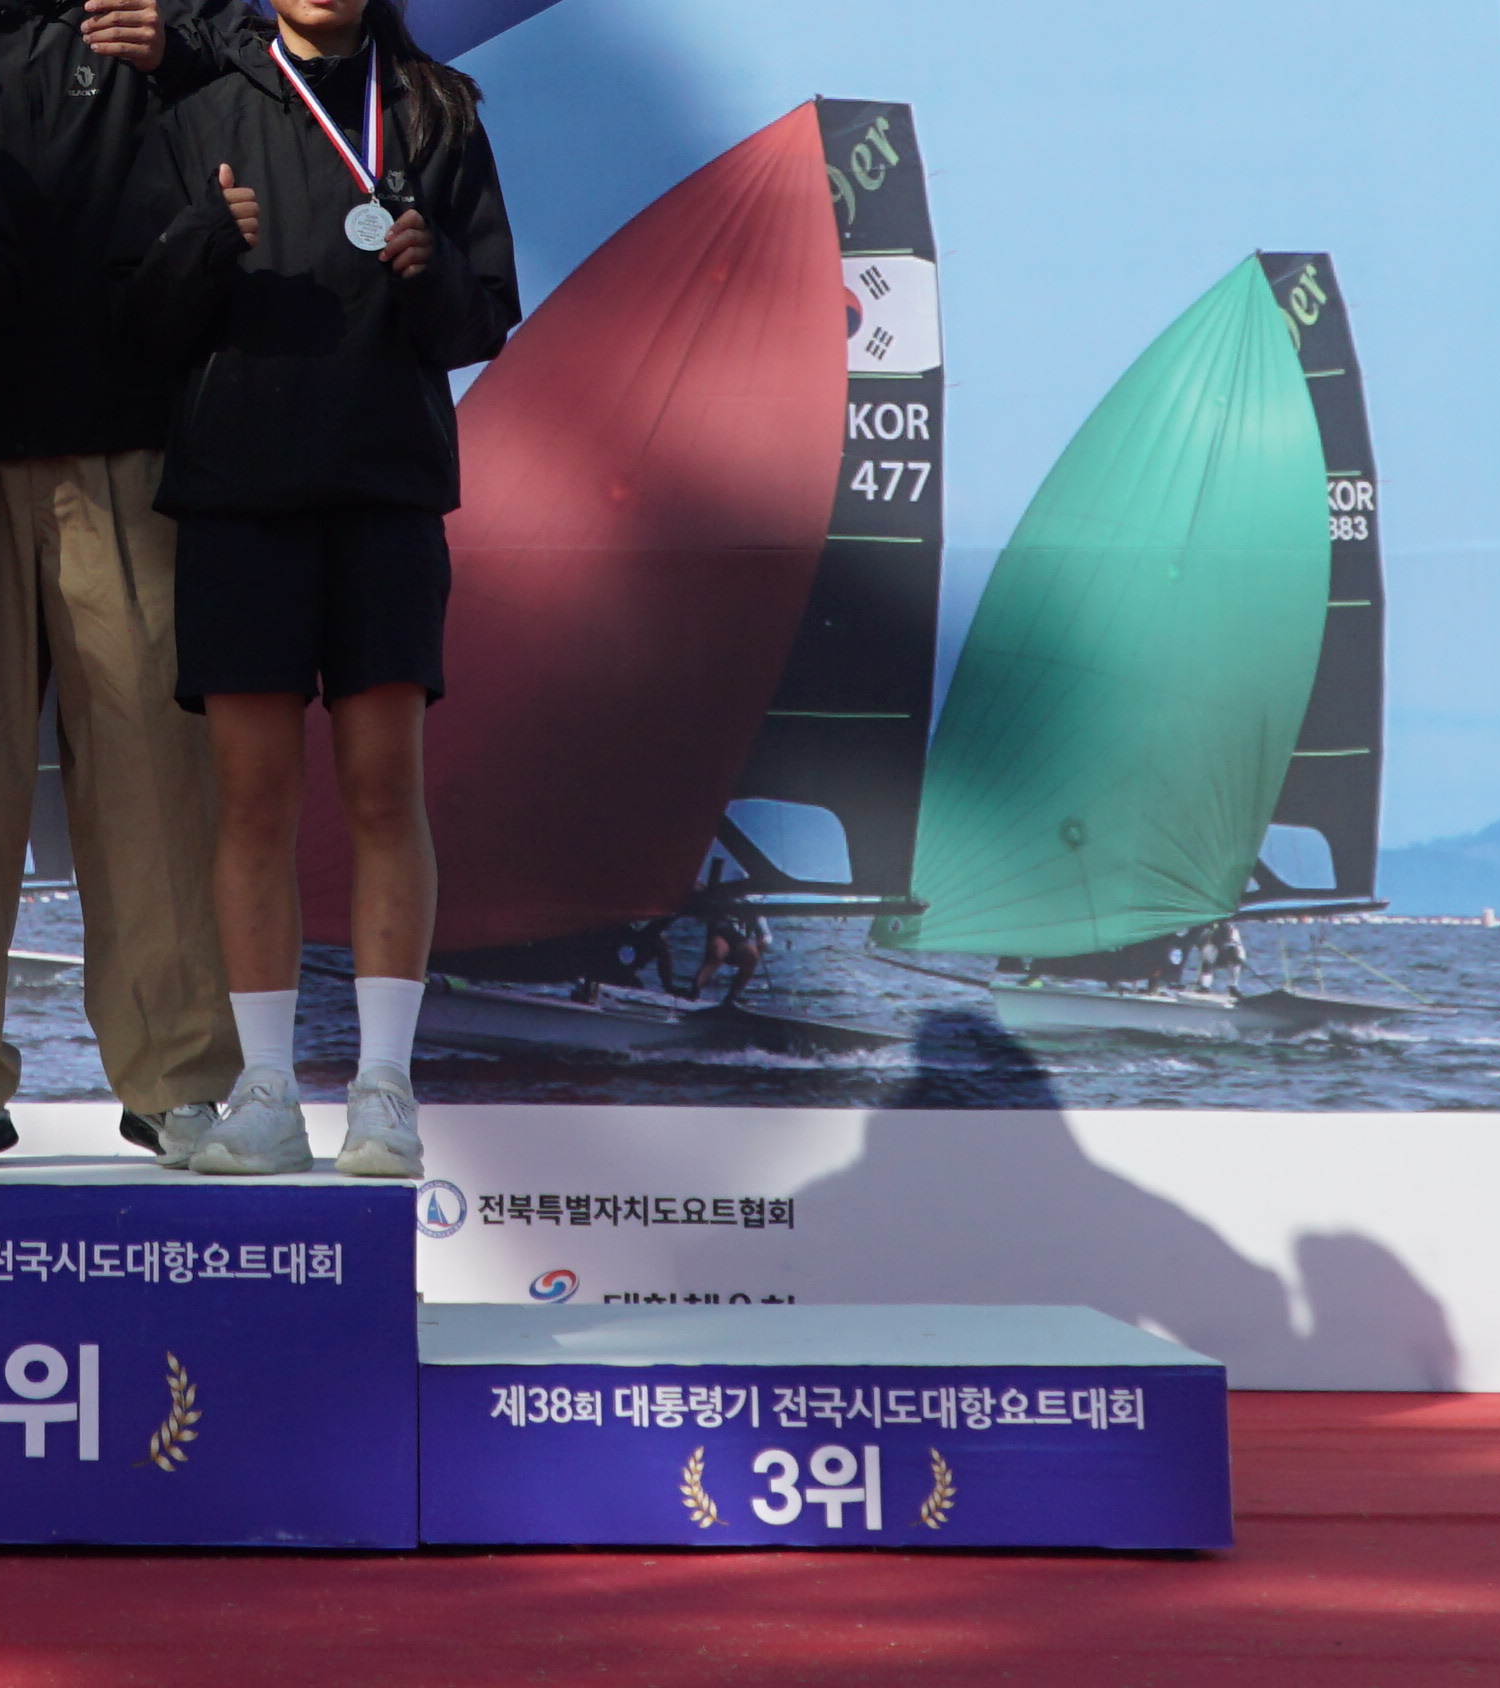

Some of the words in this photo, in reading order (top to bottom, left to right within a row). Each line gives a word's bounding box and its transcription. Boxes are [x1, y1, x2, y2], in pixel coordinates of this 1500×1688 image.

[847, 403, 930, 440] KOR
[851, 461, 931, 501] 477
[480, 1194, 794, 1229] 전북특별자치도요트협회
[491, 1385, 602, 1426] 제38회
[615, 1385, 759, 1427] 대통령기
[773, 1386, 1144, 1429] 전국시도대항요트대회
[752, 1446, 881, 1529] 3위
